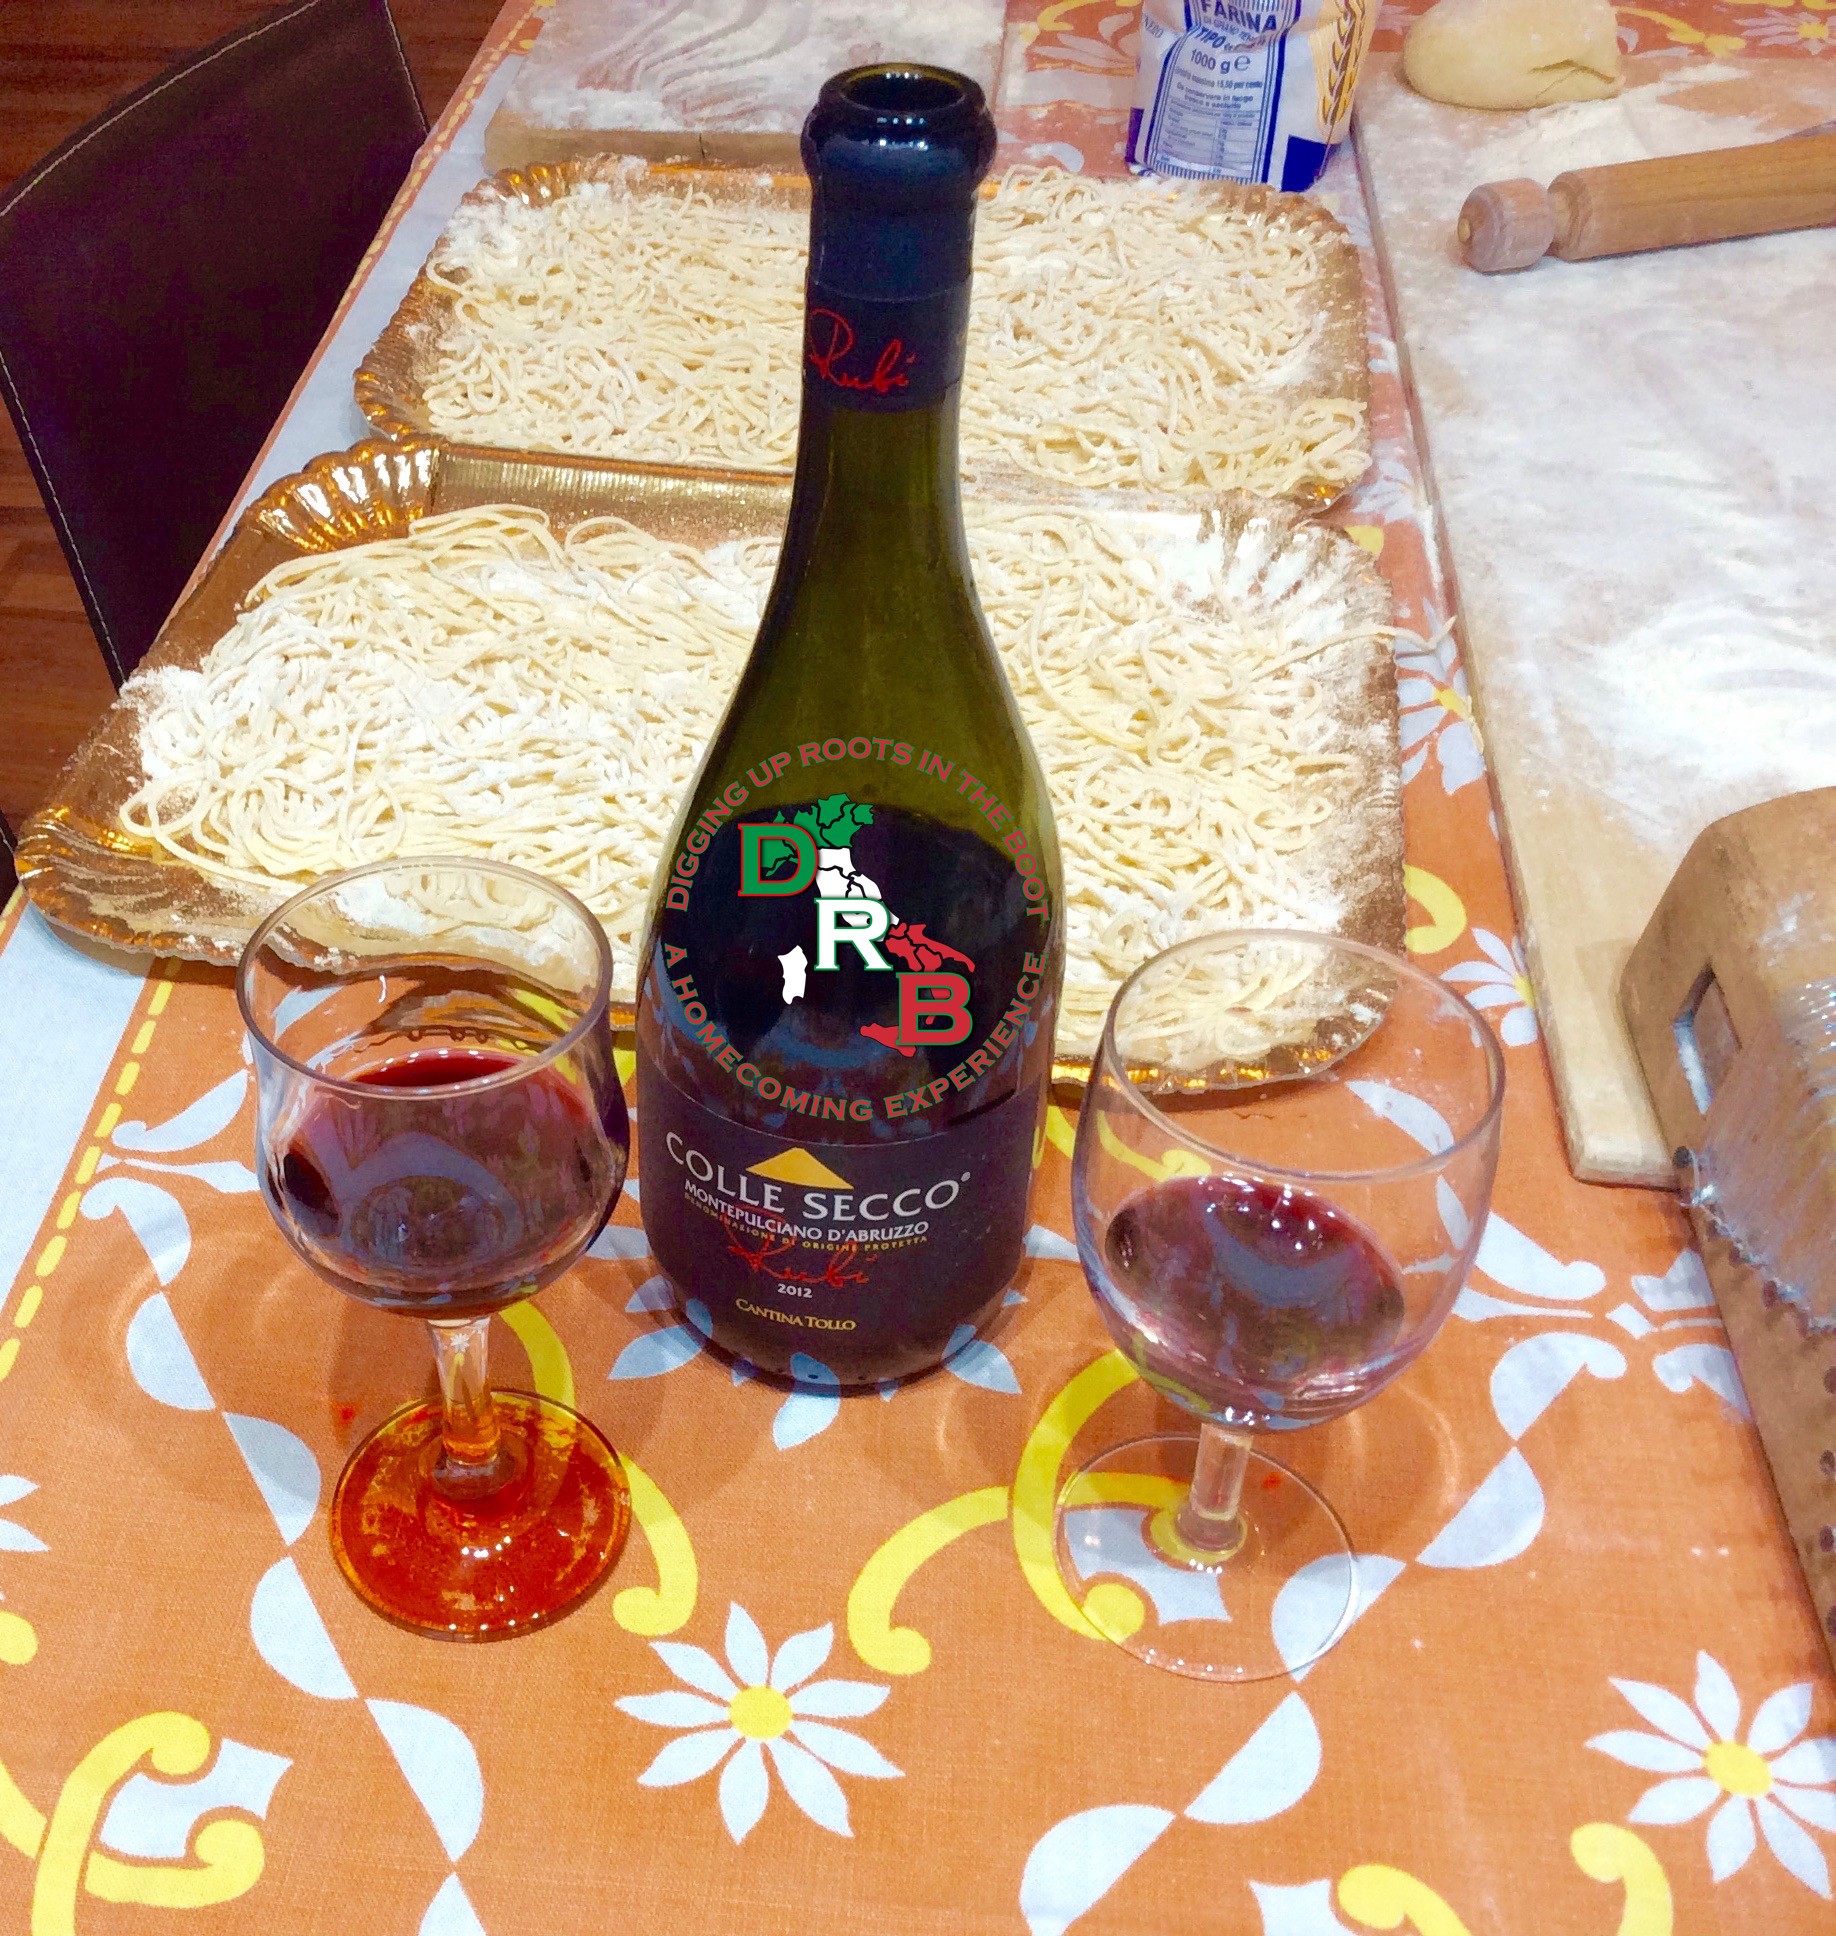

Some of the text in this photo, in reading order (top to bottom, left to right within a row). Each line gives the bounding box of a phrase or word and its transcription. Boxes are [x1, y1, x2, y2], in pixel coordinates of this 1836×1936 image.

[1201, 0, 1277, 33] FARINA
[1195, 26, 1227, 49] TIPO
[1191, 49, 1216, 70] 1000
[1219, 59, 1231, 75] g
[666, 1131, 960, 1222] COLLE SECCO
[684, 1178, 930, 1243] MONTEPULCIANO D'ABRUZZO
[801, 1240, 858, 1252] ORIGINE
[864, 1234, 928, 1252] PROTETTA
[777, 1282, 813, 1299] 2012
[735, 1298, 858, 1331] CANTINA TOLLO
